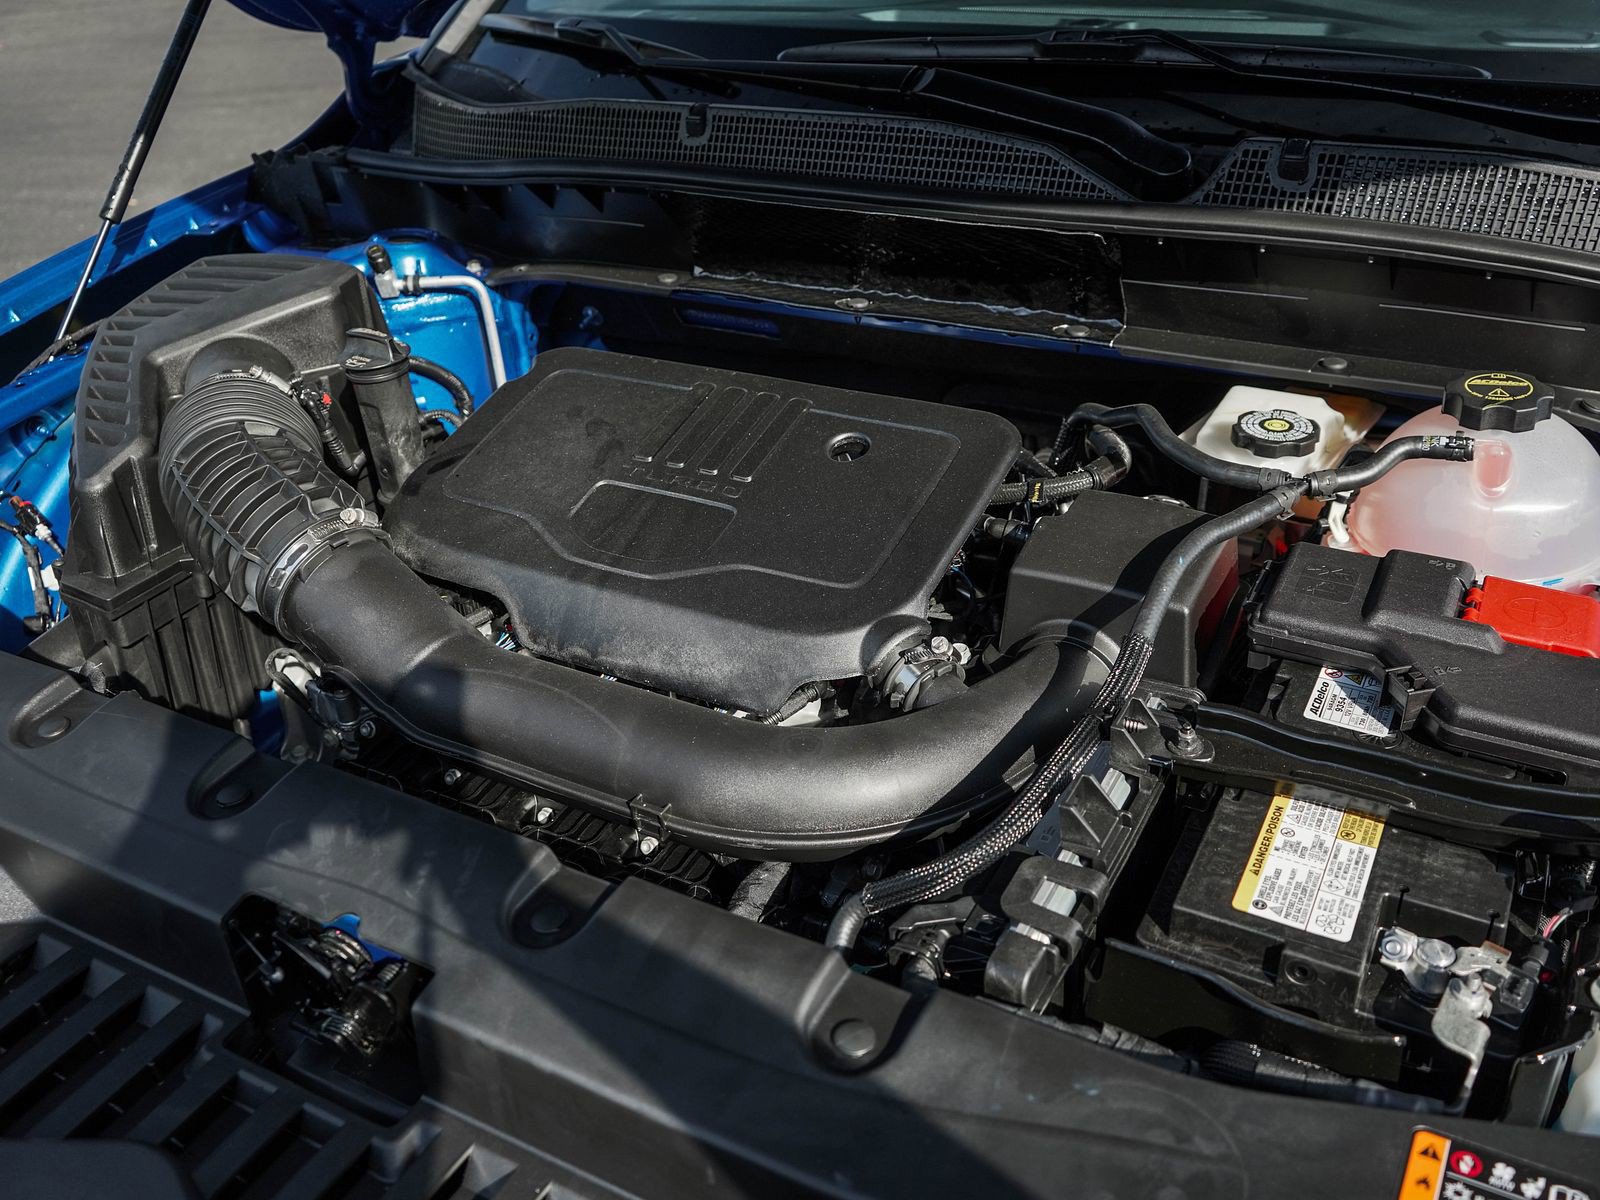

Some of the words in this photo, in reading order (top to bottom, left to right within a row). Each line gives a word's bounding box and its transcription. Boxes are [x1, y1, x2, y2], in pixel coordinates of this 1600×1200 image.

[1308, 680, 1329, 715] ACDelco
[1334, 696, 1347, 712] 9354
[1251, 805, 1284, 869] DANGER/POISON
